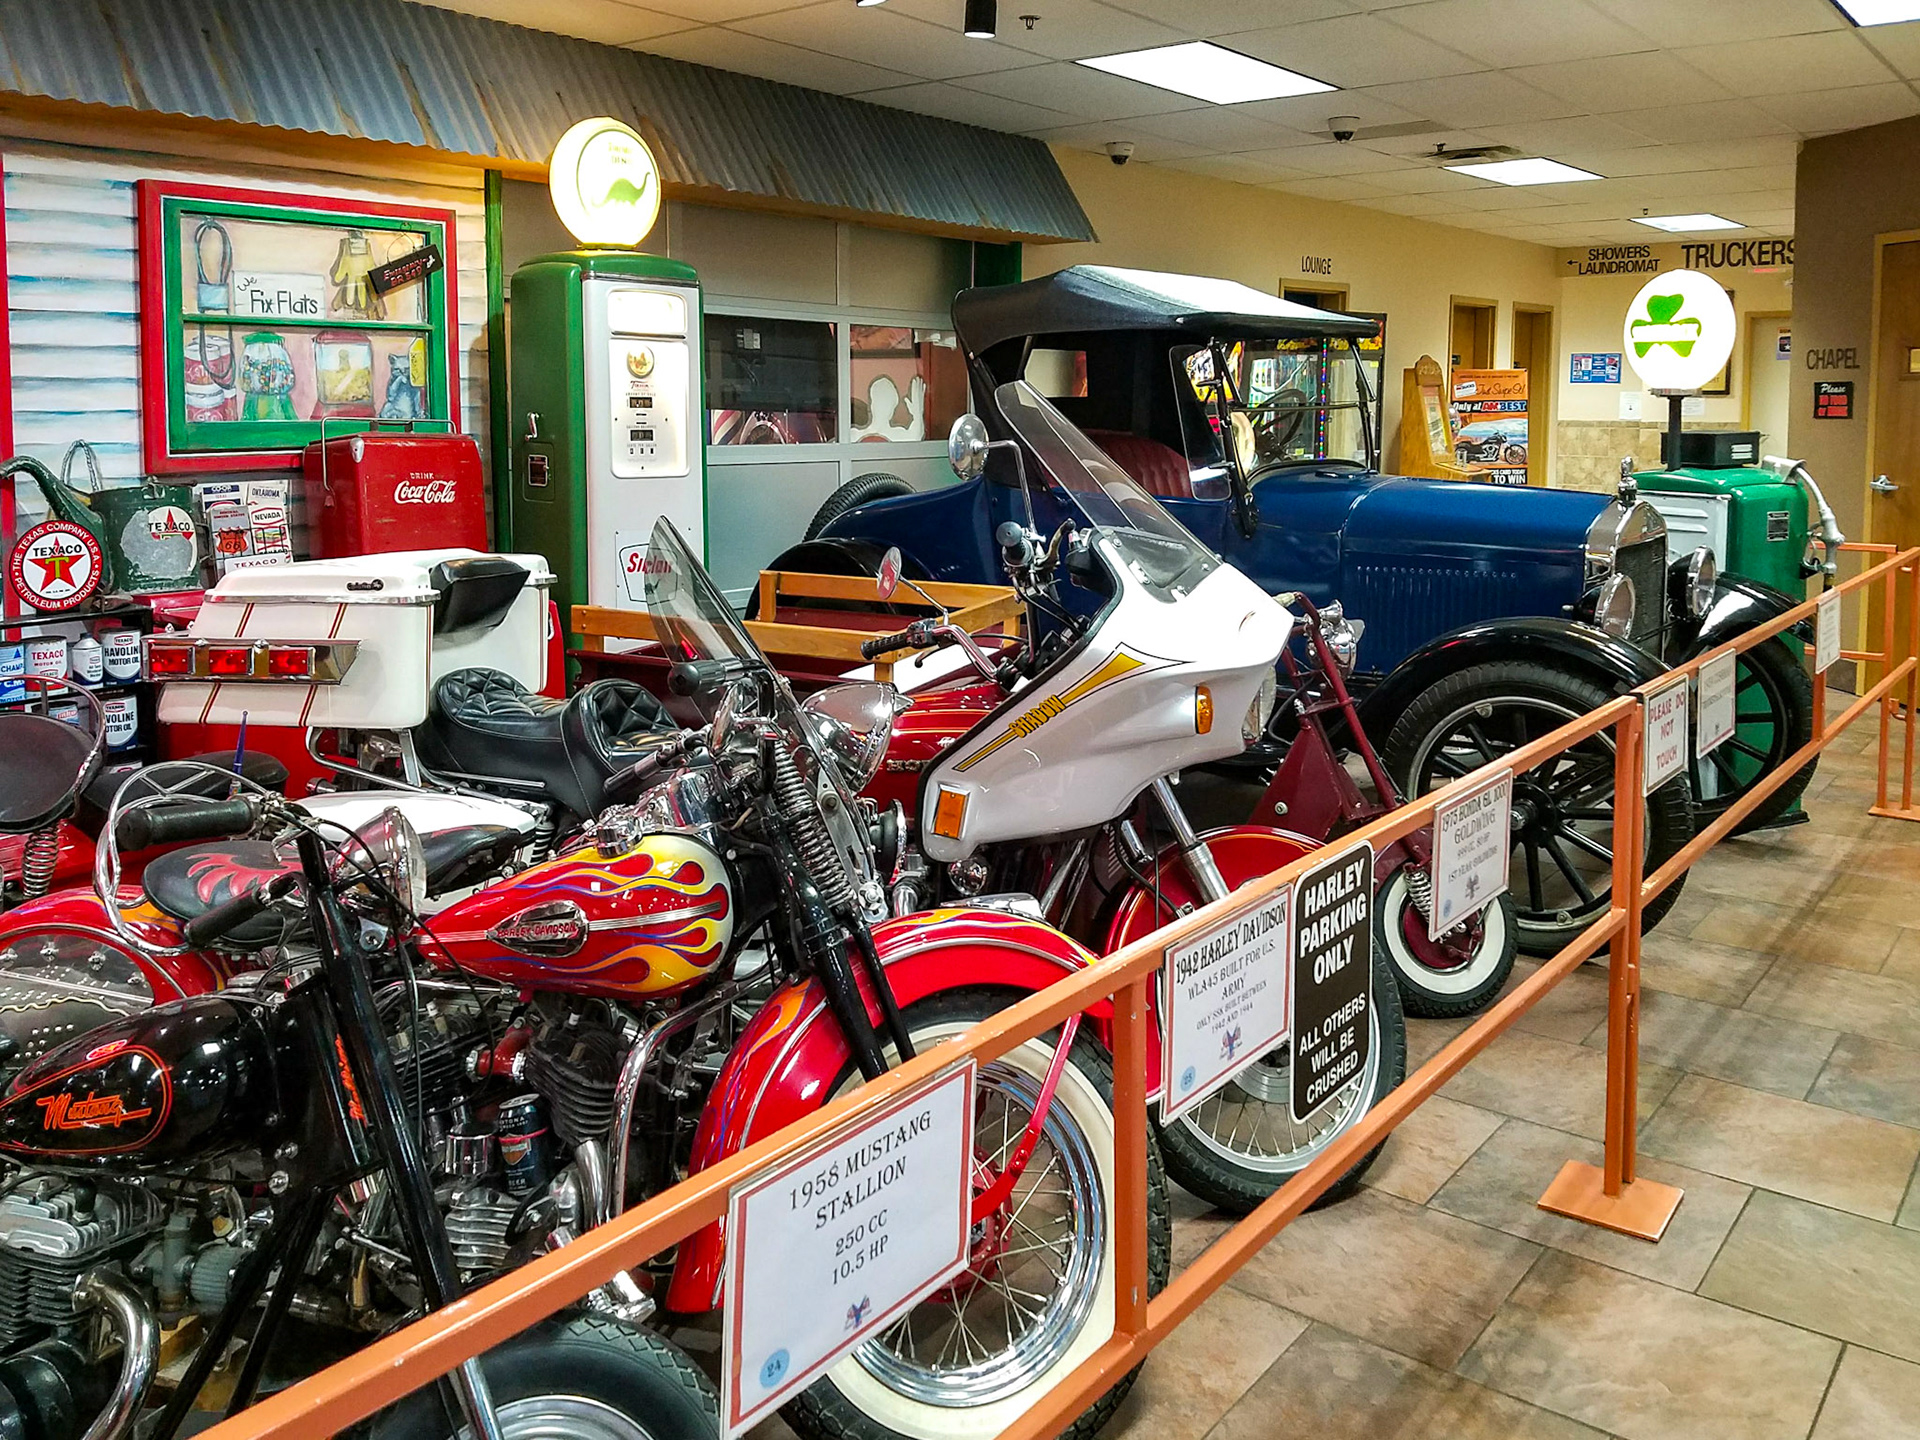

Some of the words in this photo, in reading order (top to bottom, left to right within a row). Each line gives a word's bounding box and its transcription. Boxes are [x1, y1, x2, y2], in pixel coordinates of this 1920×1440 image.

[1301, 255, 1332, 275] LOUNGE
[1588, 246, 1650, 261] SHOWERS
[1578, 259, 1660, 275] LAUNDROMAT
[236, 276, 258, 292] We
[251, 289, 273, 314] Fix
[278, 291, 318, 315] Flats
[1806, 347, 1860, 370] CHAPEL
[409, 472, 435, 480] DRINK
[1493, 475, 1506, 484] TO
[1507, 475, 1526, 484] WIN
[394, 480, 457, 504] Coca-Cola
[148, 522, 190, 532] TEXACO
[254, 512, 281, 521] NEVADA
[12, 552, 23, 571] THE
[18, 527, 44, 550] TEXAS
[46, 522, 89, 540] COMPANY
[33, 544, 82, 557] TEXACO
[224, 541, 240, 550] 66
[234, 558, 278, 568] TEXACO
[15, 577, 60, 609] PETROLEUM
[63, 570, 99, 607] PRODUCTS
[32, 649, 64, 660] TEXACO
[1008, 694, 1067, 738] SHADOW
[1650, 698, 1672, 724] PLEASE
[124, 723, 132, 731] OIL
[1656, 745, 1677, 769] TOUCH
[1304, 857, 1366, 918] HARLEY
[1300, 892, 1367, 958] PARKING
[1176, 951, 1199, 985] 1942
[1200, 921, 1242, 970] HARLEY
[1243, 901, 1287, 945] DAVIDSON
[1220, 956, 1244, 981] BUILT
[1245, 947, 1260, 966] FOR
[1313, 934, 1355, 985] ONLY
[1221, 972, 1247, 1000] ARMY
[1299, 1029, 1321, 1056] ALL
[1323, 992, 1366, 1032] OTHERS
[1310, 1039, 1338, 1074] WILL
[1340, 1026, 1355, 1049] BE
[1306, 1050, 1359, 1105] CRUSHED
[36, 1092, 126, 1130] Mustang
[789, 1159, 840, 1211] 1958
[845, 1110, 932, 1179] MUSTANG
[815, 1156, 907, 1230] STALLION
[835, 1221, 865, 1257] 250
[868, 1209, 889, 1237] CC
[831, 1251, 865, 1286] 10.5
[869, 1234, 889, 1262] HP
